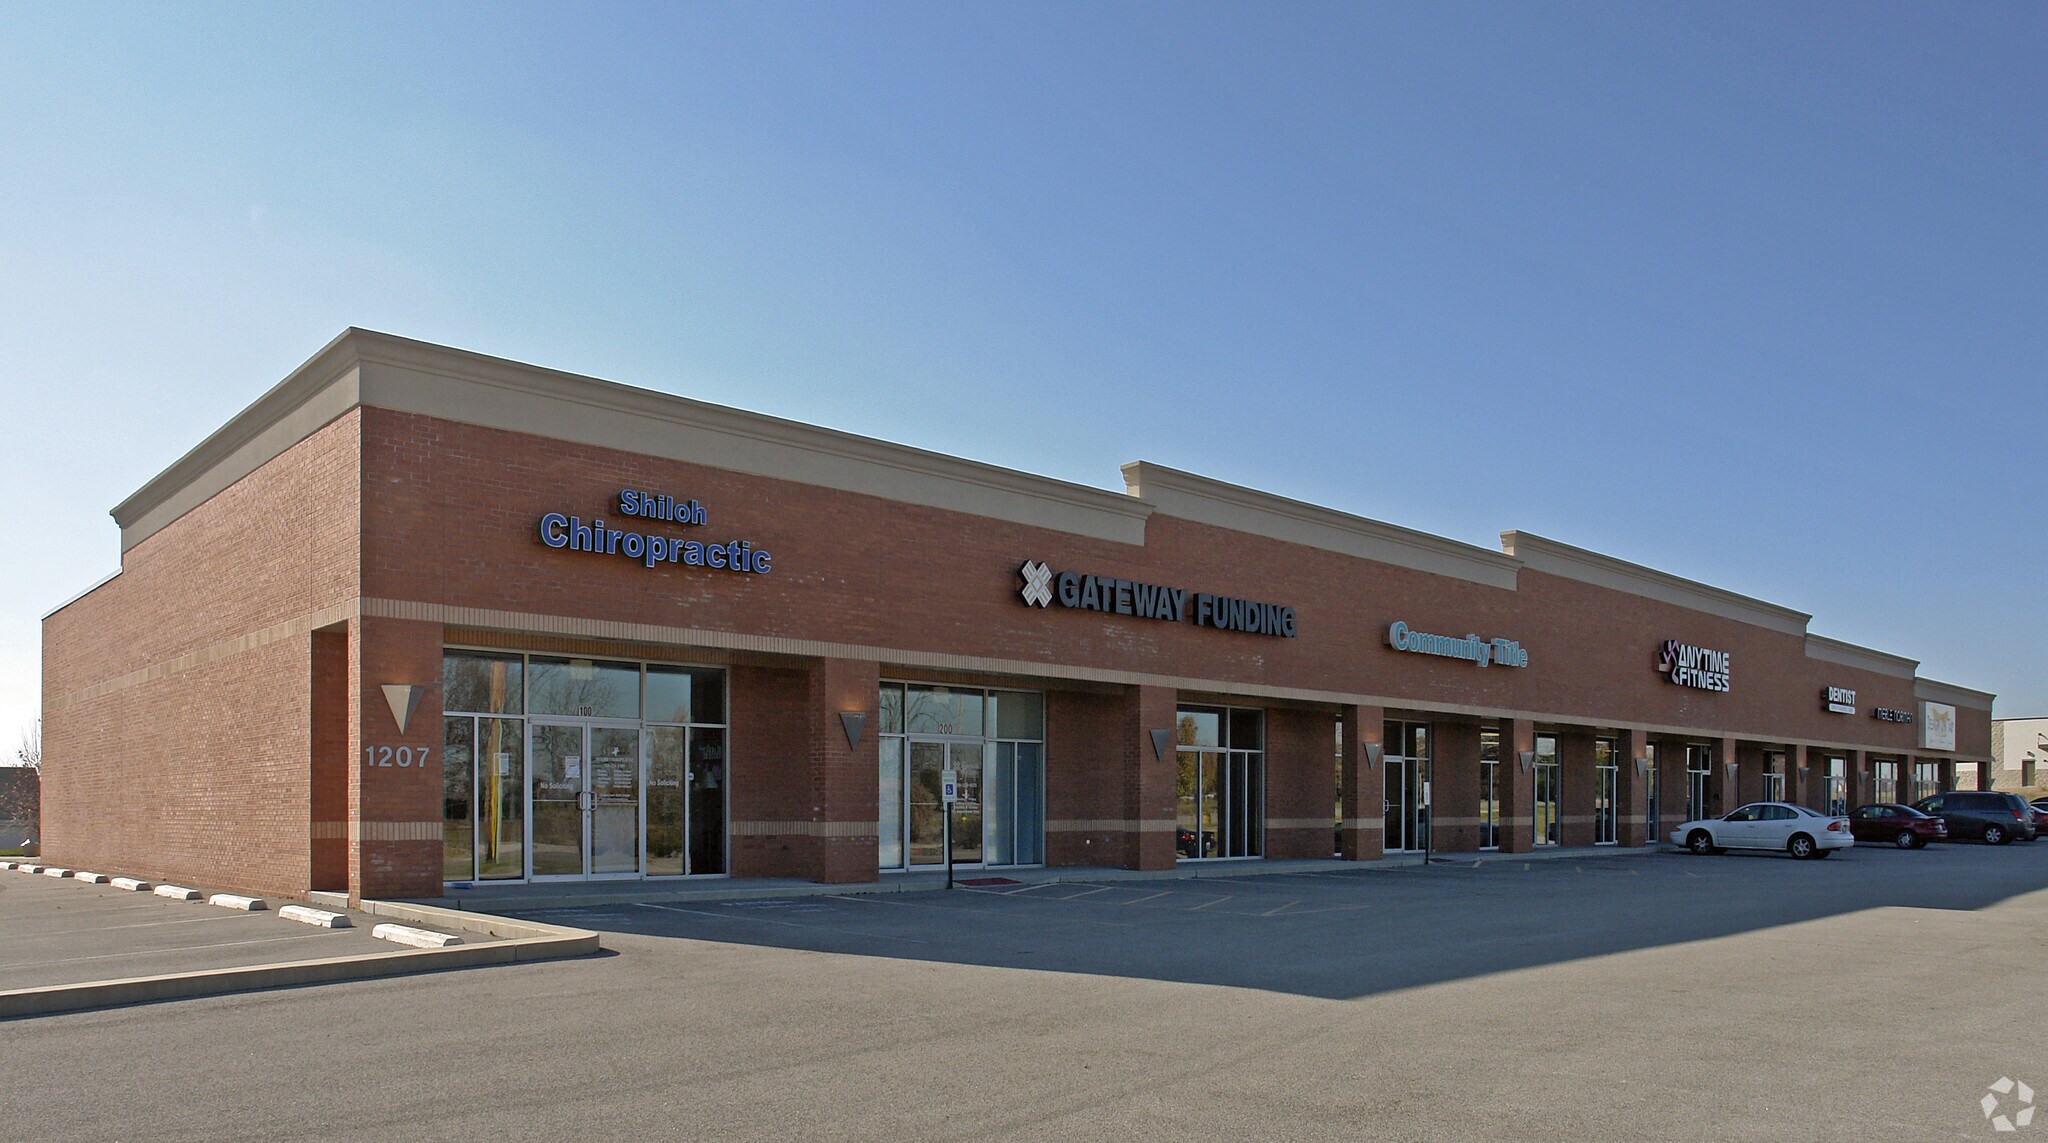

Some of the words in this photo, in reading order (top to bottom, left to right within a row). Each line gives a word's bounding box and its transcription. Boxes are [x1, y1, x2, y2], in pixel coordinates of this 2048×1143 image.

[620, 488, 707, 526] Shiloh
[540, 512, 772, 574] Chiropractic
[1056, 570, 1187, 622] GATEWAY
[1196, 592, 1297, 638] FUNDING
[1390, 620, 1491, 668] Community
[1491, 637, 1528, 668] Title
[1678, 643, 1730, 675] ANYTIME
[1679, 667, 1730, 693] FITNESS
[1828, 686, 1856, 705] DENTIST
[579, 705, 592, 717] 100
[940, 723, 953, 735] 200
[365, 745, 430, 768] 1207
